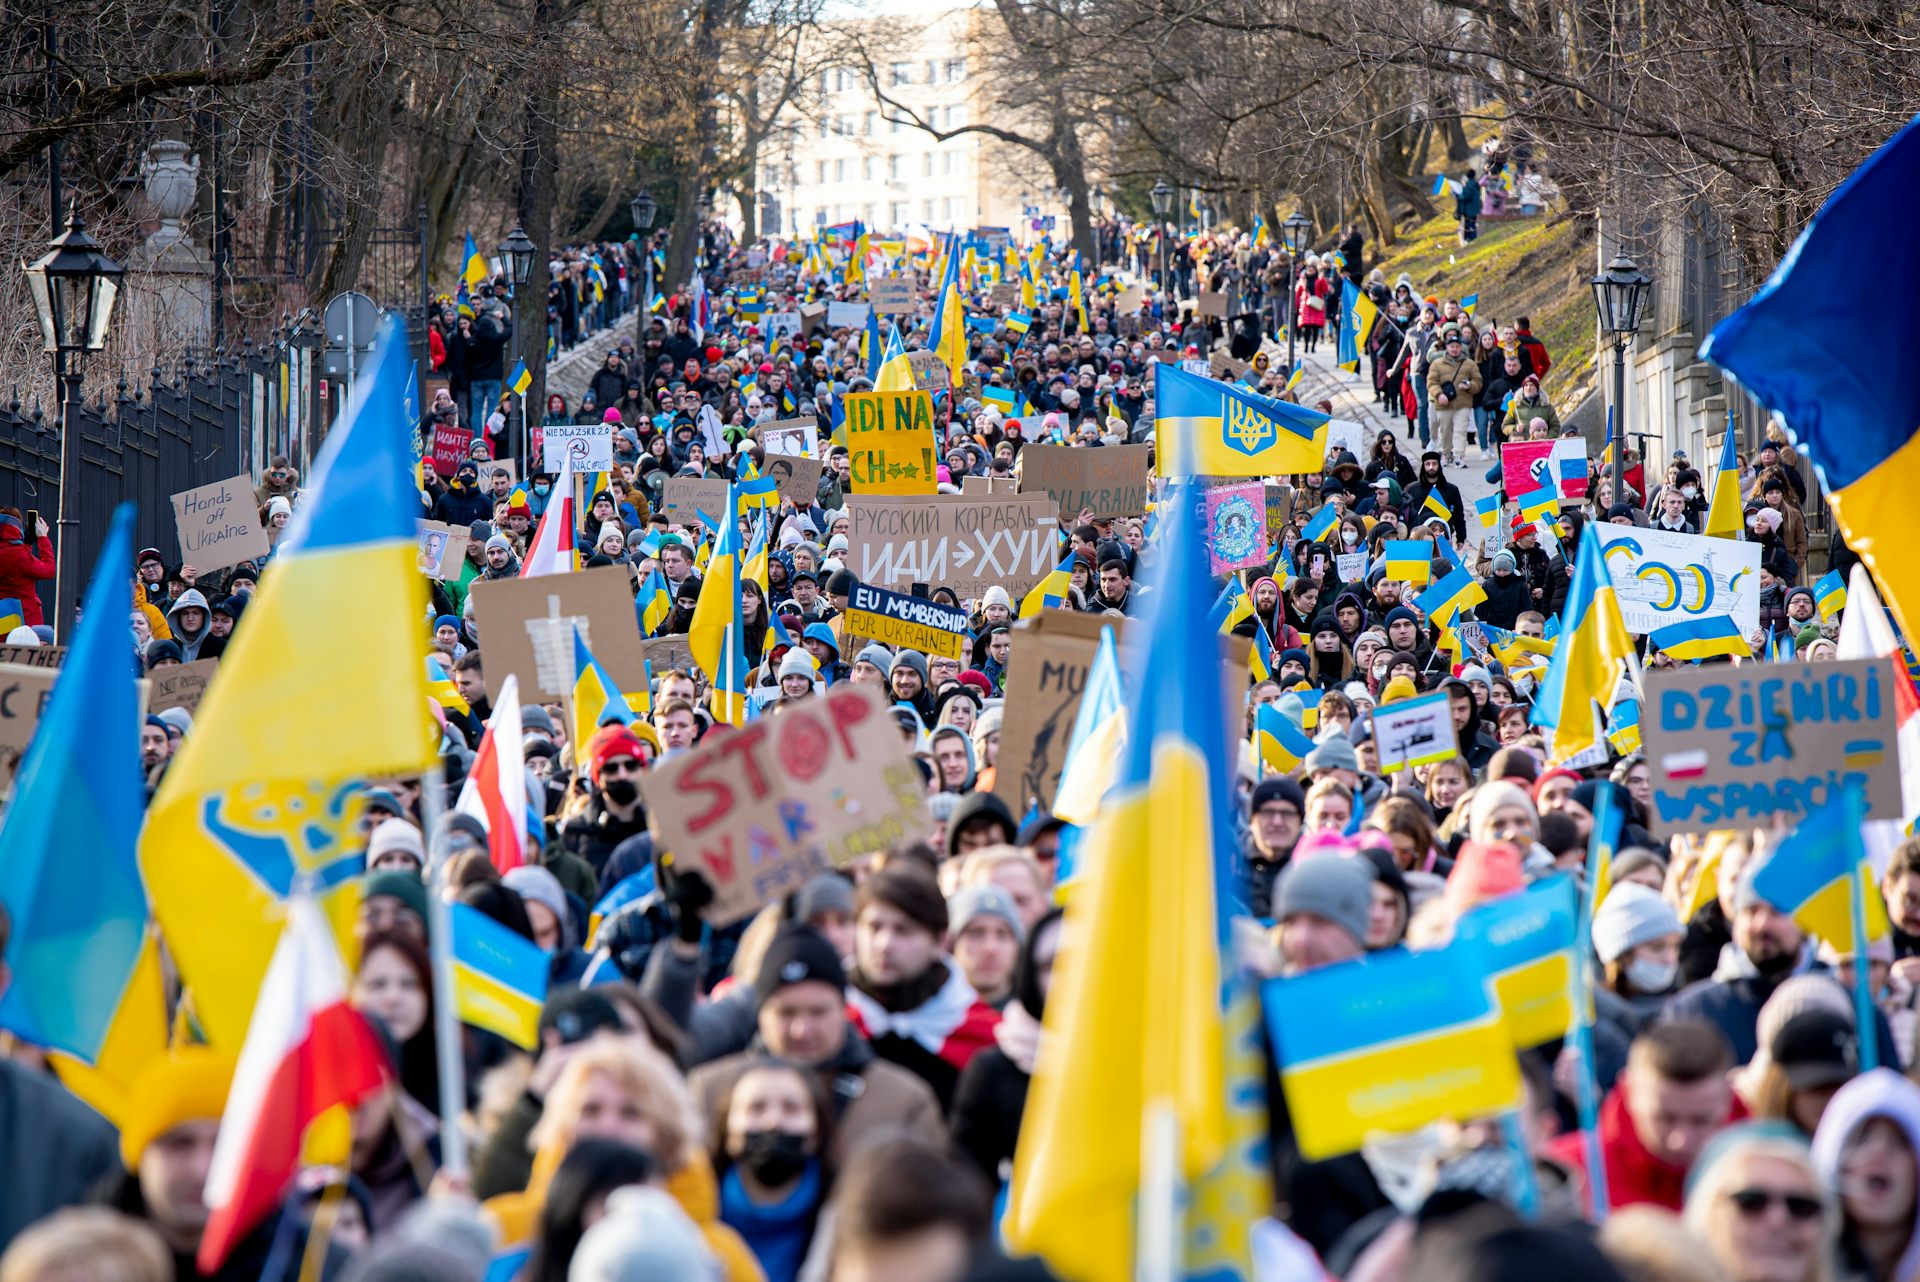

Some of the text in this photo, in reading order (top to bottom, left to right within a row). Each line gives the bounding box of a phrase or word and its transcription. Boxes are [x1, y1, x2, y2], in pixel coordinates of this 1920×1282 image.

[849, 395, 930, 432] IDI NA
[1042, 452, 1145, 481] NO WAR
[184, 486, 232, 515] Hands
[206, 507, 226, 525] off
[856, 504, 1036, 538] РУССКИЙ КОРАБЛЬ
[1268, 517, 1283, 529] US
[862, 516, 1059, 585] ИДИ ХУЙ
[851, 613, 875, 635] FOR
[855, 587, 967, 633] EU MEMBERSHIP
[676, 692, 871, 834] STOP
[1729, 730, 1793, 766] ZA
